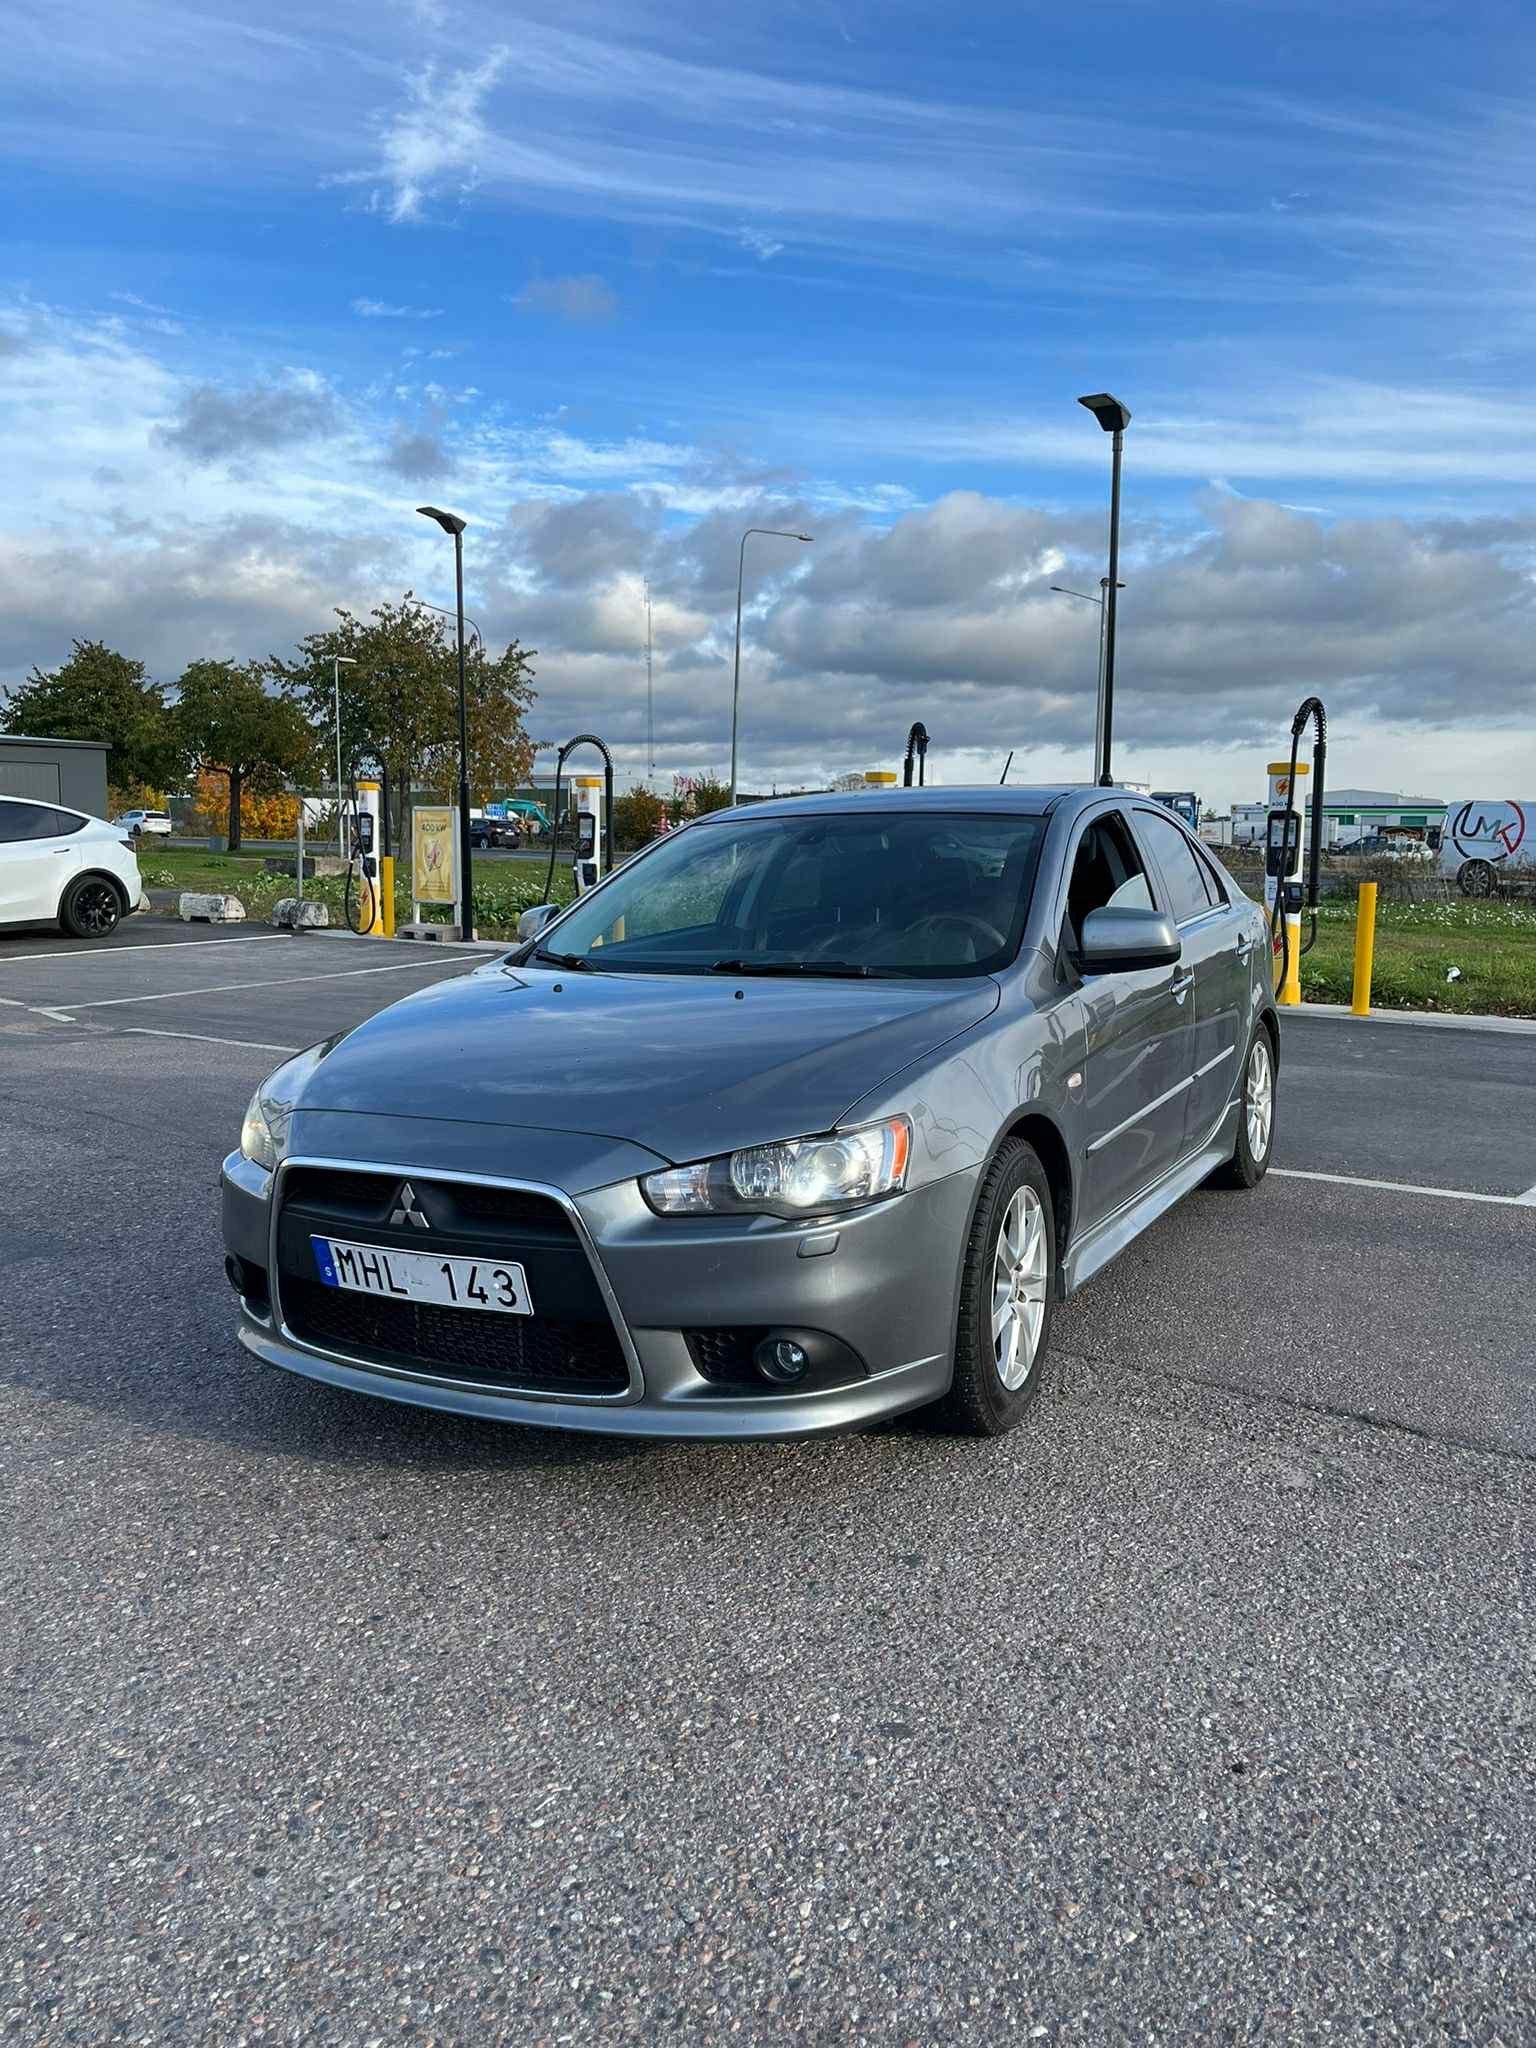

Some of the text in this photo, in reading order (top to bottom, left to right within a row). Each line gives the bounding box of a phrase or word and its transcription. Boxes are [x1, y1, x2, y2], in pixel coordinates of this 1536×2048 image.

[324, 1266, 332, 1277] S
[334, 1246, 517, 1307] MHL 143
